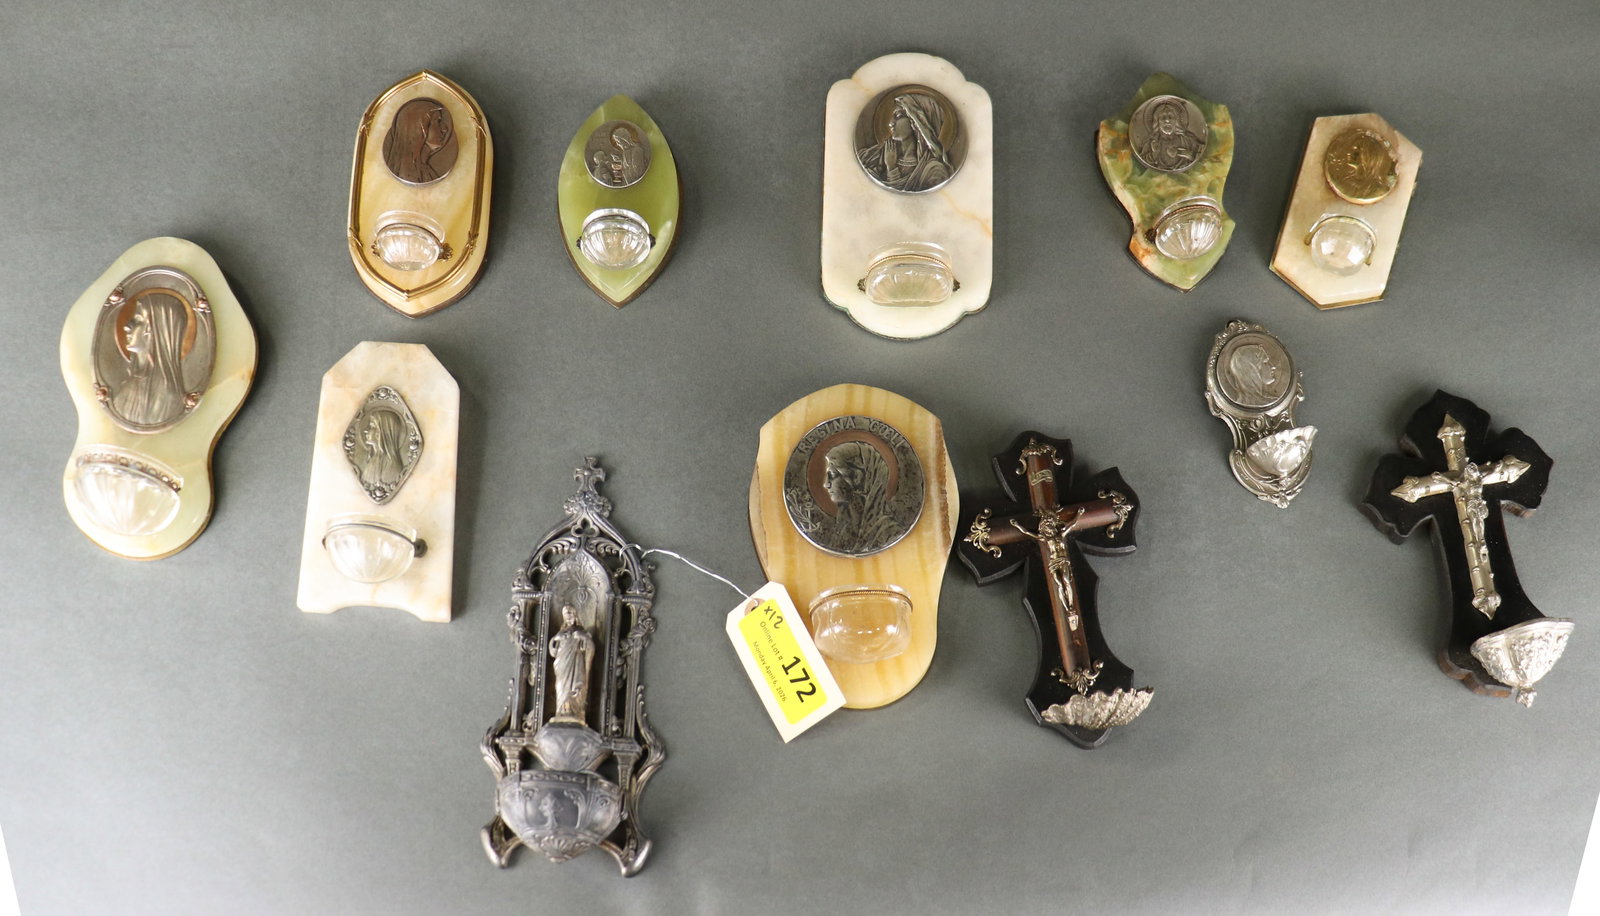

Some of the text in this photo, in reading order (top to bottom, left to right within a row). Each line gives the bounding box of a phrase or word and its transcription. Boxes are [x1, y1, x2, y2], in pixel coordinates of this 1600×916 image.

[798, 416, 856, 453] REGINA
[759, 621, 774, 643] Online
[770, 642, 780, 657] Lot
[752, 641, 767, 667] Monday
[764, 665, 775, 681] April
[781, 656, 817, 703] 172
